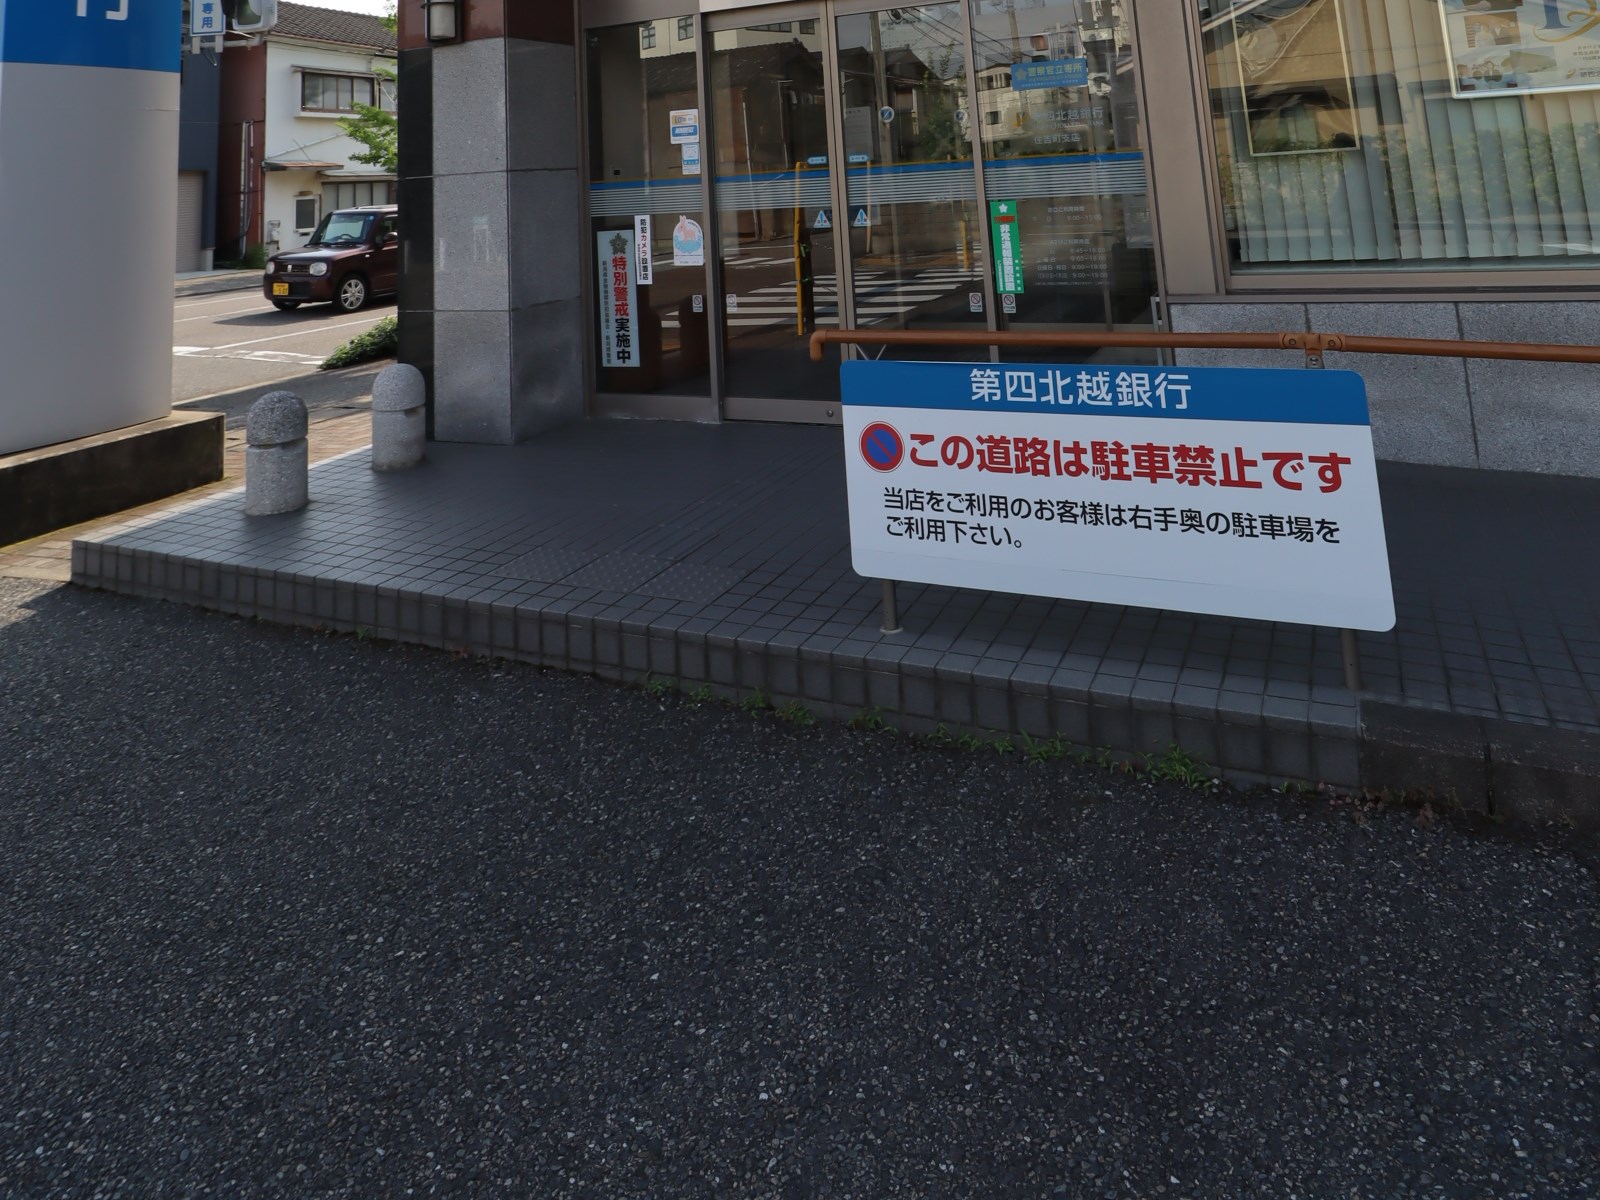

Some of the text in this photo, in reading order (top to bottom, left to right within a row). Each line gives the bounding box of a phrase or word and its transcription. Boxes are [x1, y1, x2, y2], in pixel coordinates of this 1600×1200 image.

[201, 2, 214, 29] 専用
[639, 218, 649, 281] 防犯カメラ設置店
[612, 256, 631, 364] 特別警戒実施中
[969, 367, 1192, 410] 第四北越銀行
[909, 432, 1352, 494] この道路は駐車禁止です
[883, 486, 1341, 545] 当店をご利用のお客様は右手奥の駐車場を
[886, 516, 1024, 550] ご利用下さい。
